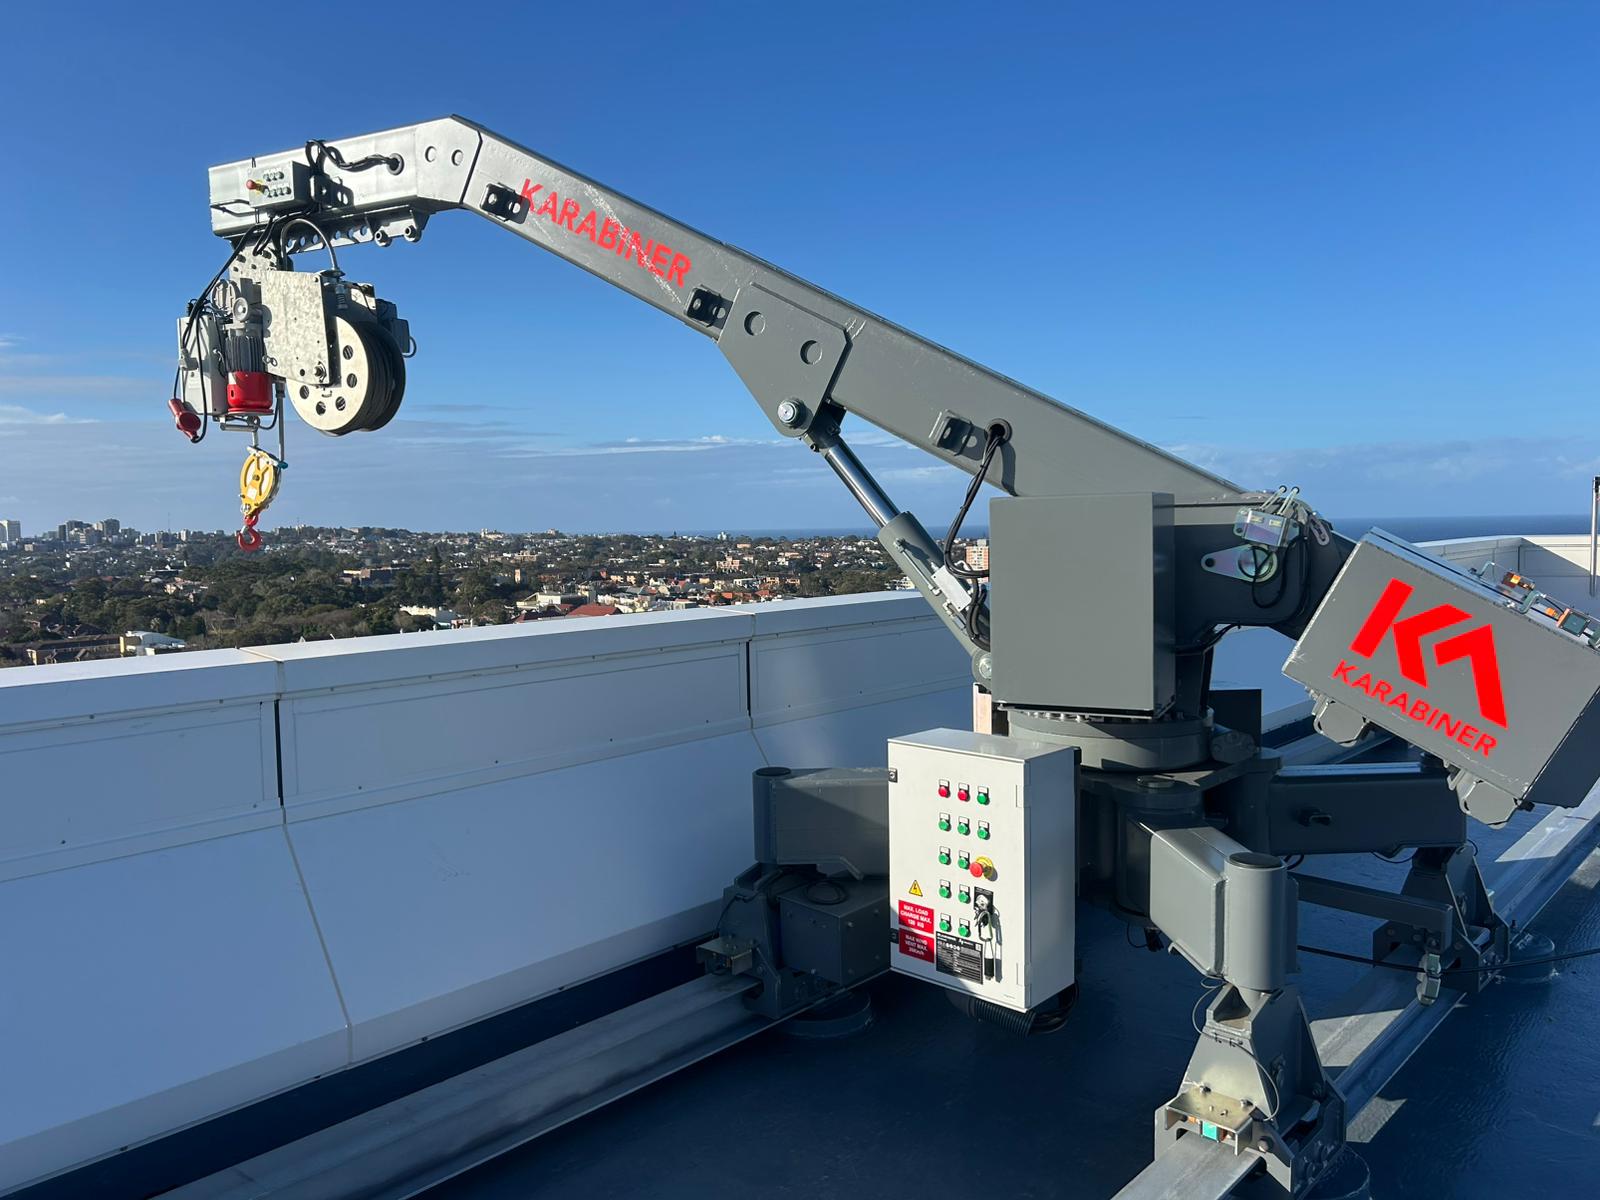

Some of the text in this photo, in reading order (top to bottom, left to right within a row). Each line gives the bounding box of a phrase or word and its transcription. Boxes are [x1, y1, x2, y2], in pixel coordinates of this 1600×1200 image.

[520, 178, 691, 288] KARABINER
[1332, 659, 1498, 758] KARABINER
[915, 907, 929, 916] LOAD
